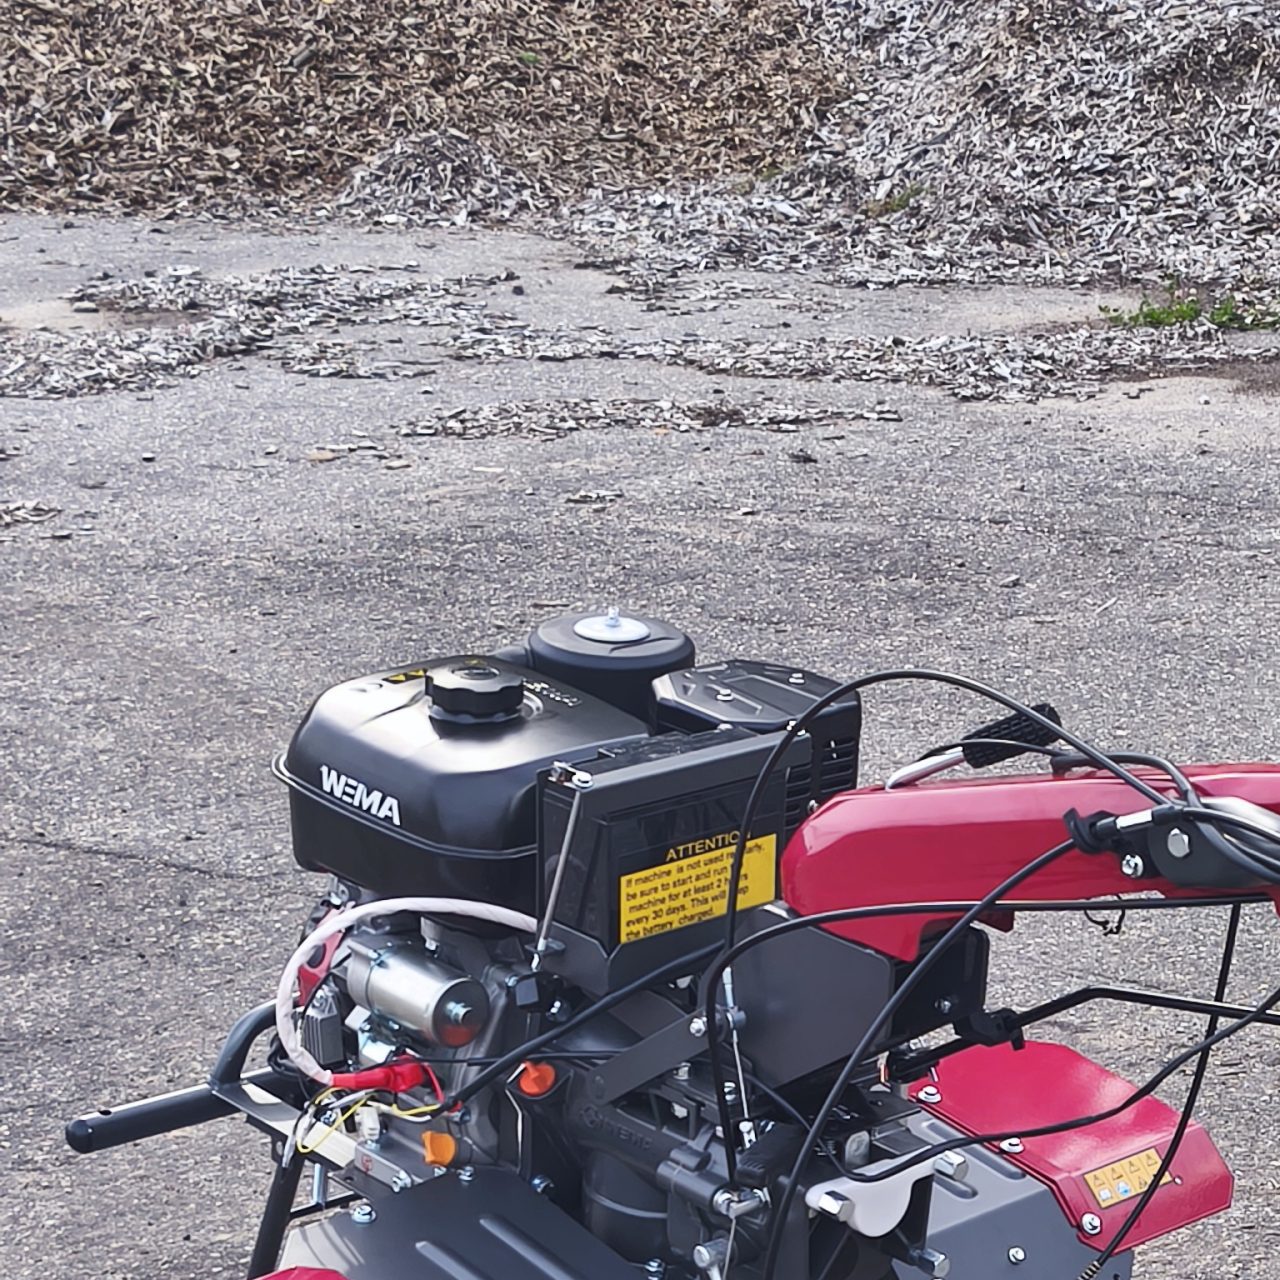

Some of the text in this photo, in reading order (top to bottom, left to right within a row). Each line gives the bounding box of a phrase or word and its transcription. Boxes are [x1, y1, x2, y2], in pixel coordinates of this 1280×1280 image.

[320, 765, 400, 825] WEMA
[665, 831, 751, 862] ATTENTIO
[626, 866, 728, 902] be sure to start and run
[635, 868, 672, 886] machine
[676, 864, 684, 874] is
[686, 860, 701, 872] not
[703, 853, 724, 867] used
[626, 914, 649, 927] every
[652, 909, 664, 921] 30
[691, 897, 709, 912] This
[711, 889, 727, 904] will
[629, 895, 667, 913] machine
[669, 890, 681, 902] for
[683, 885, 692, 897] at
[693, 879, 715, 895] least
[716, 878, 722, 889] 2
[626, 929, 641, 942] the
[643, 921, 673, 936] battery
